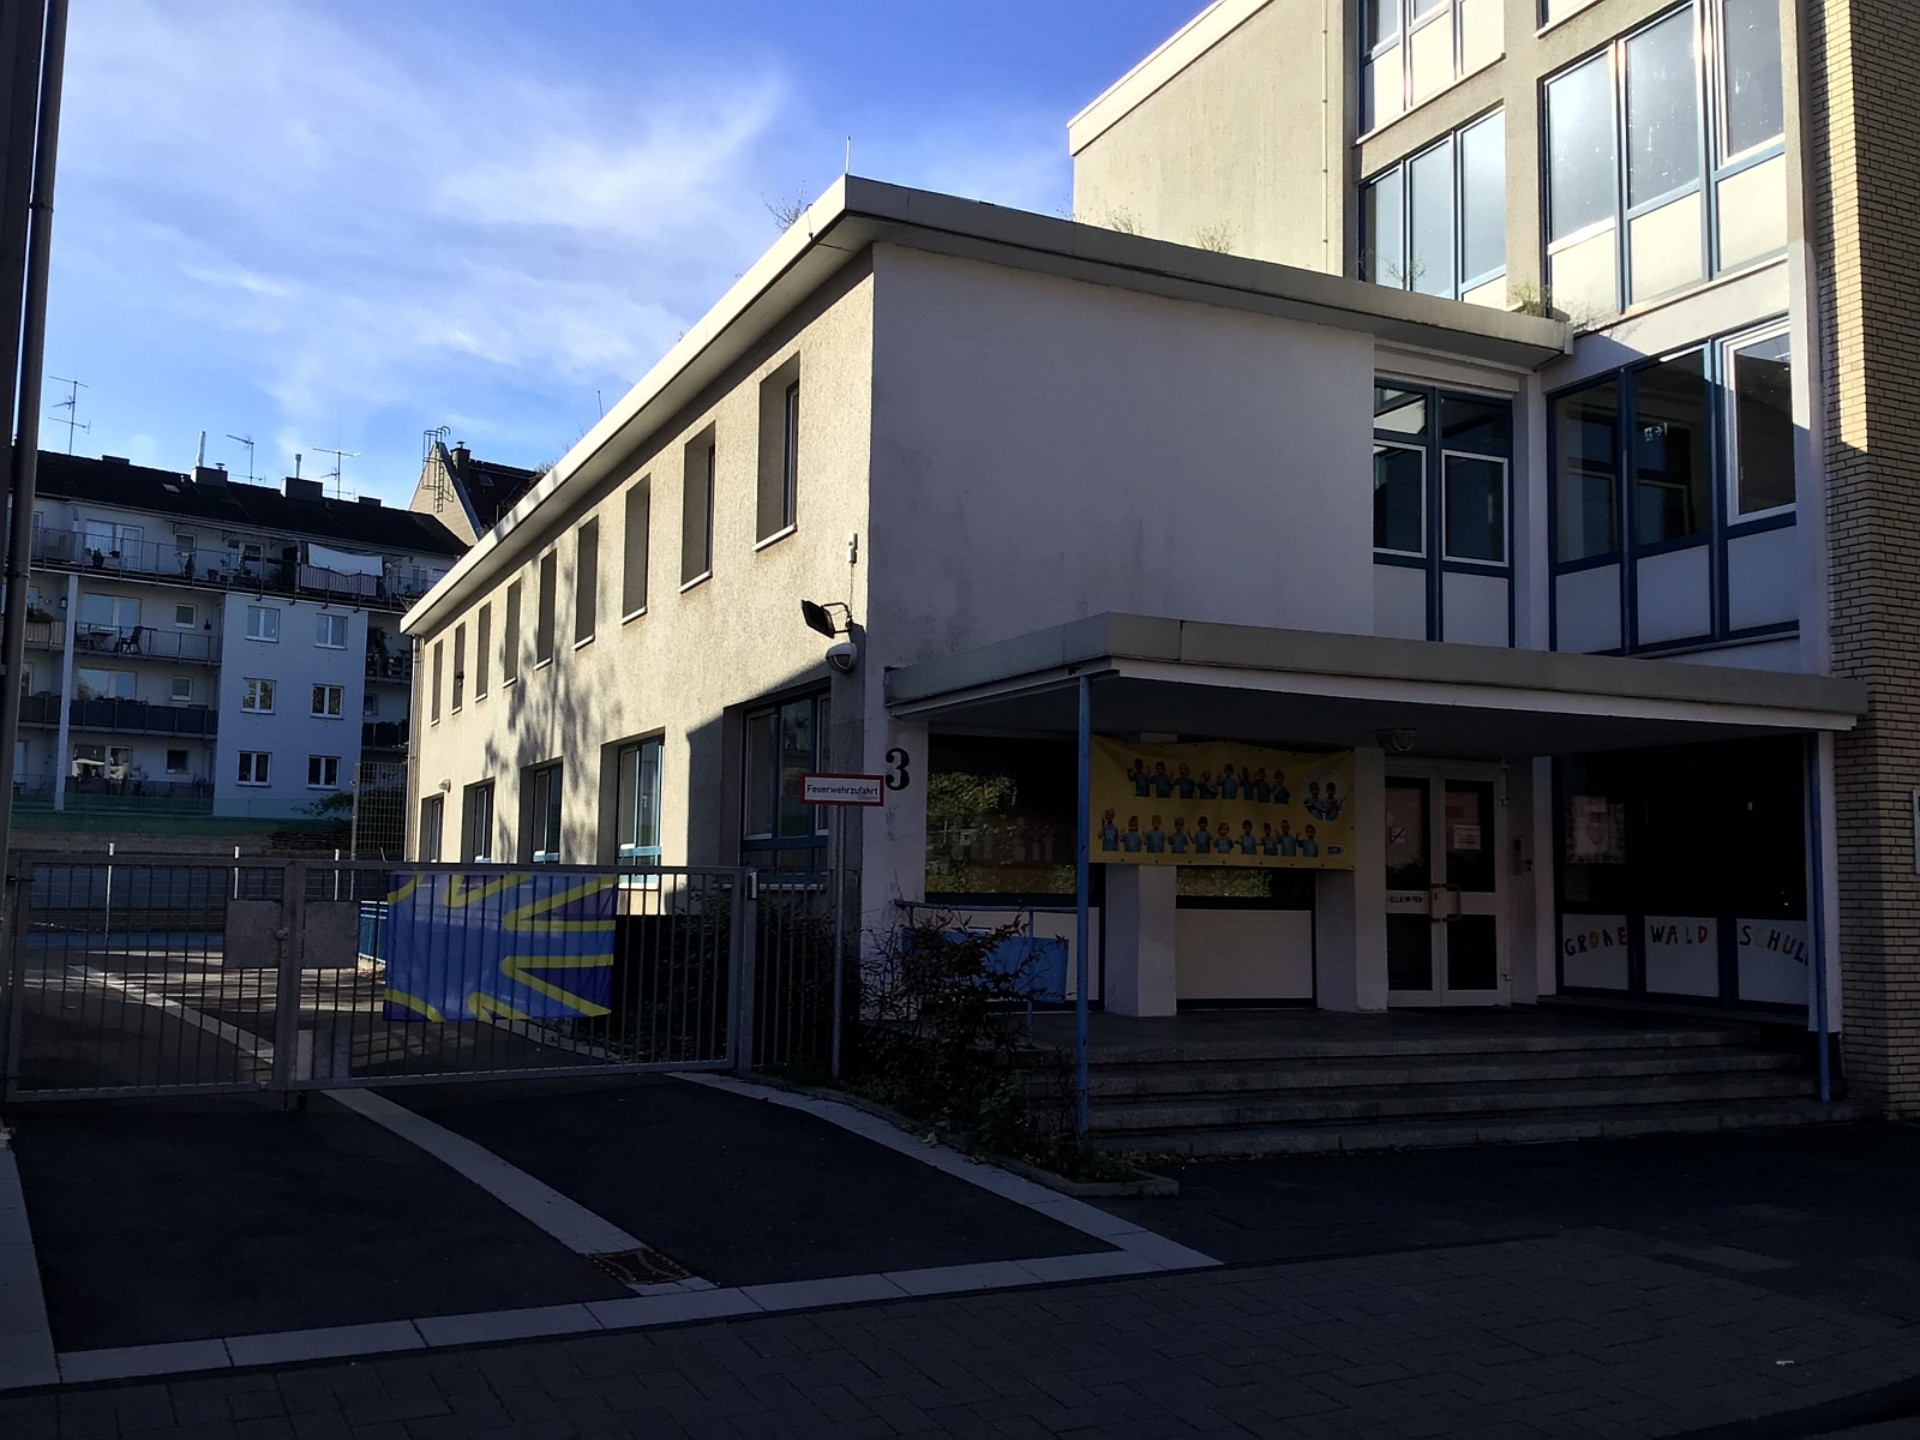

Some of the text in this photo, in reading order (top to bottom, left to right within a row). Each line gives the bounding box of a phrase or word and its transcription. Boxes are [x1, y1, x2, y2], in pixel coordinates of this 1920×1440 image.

[806, 784, 878, 795] Feuerwehrzufahrt
[885, 747, 910, 791] 3
[1650, 925, 1708, 945] WALD
[1739, 925, 1809, 966] SCHUL
